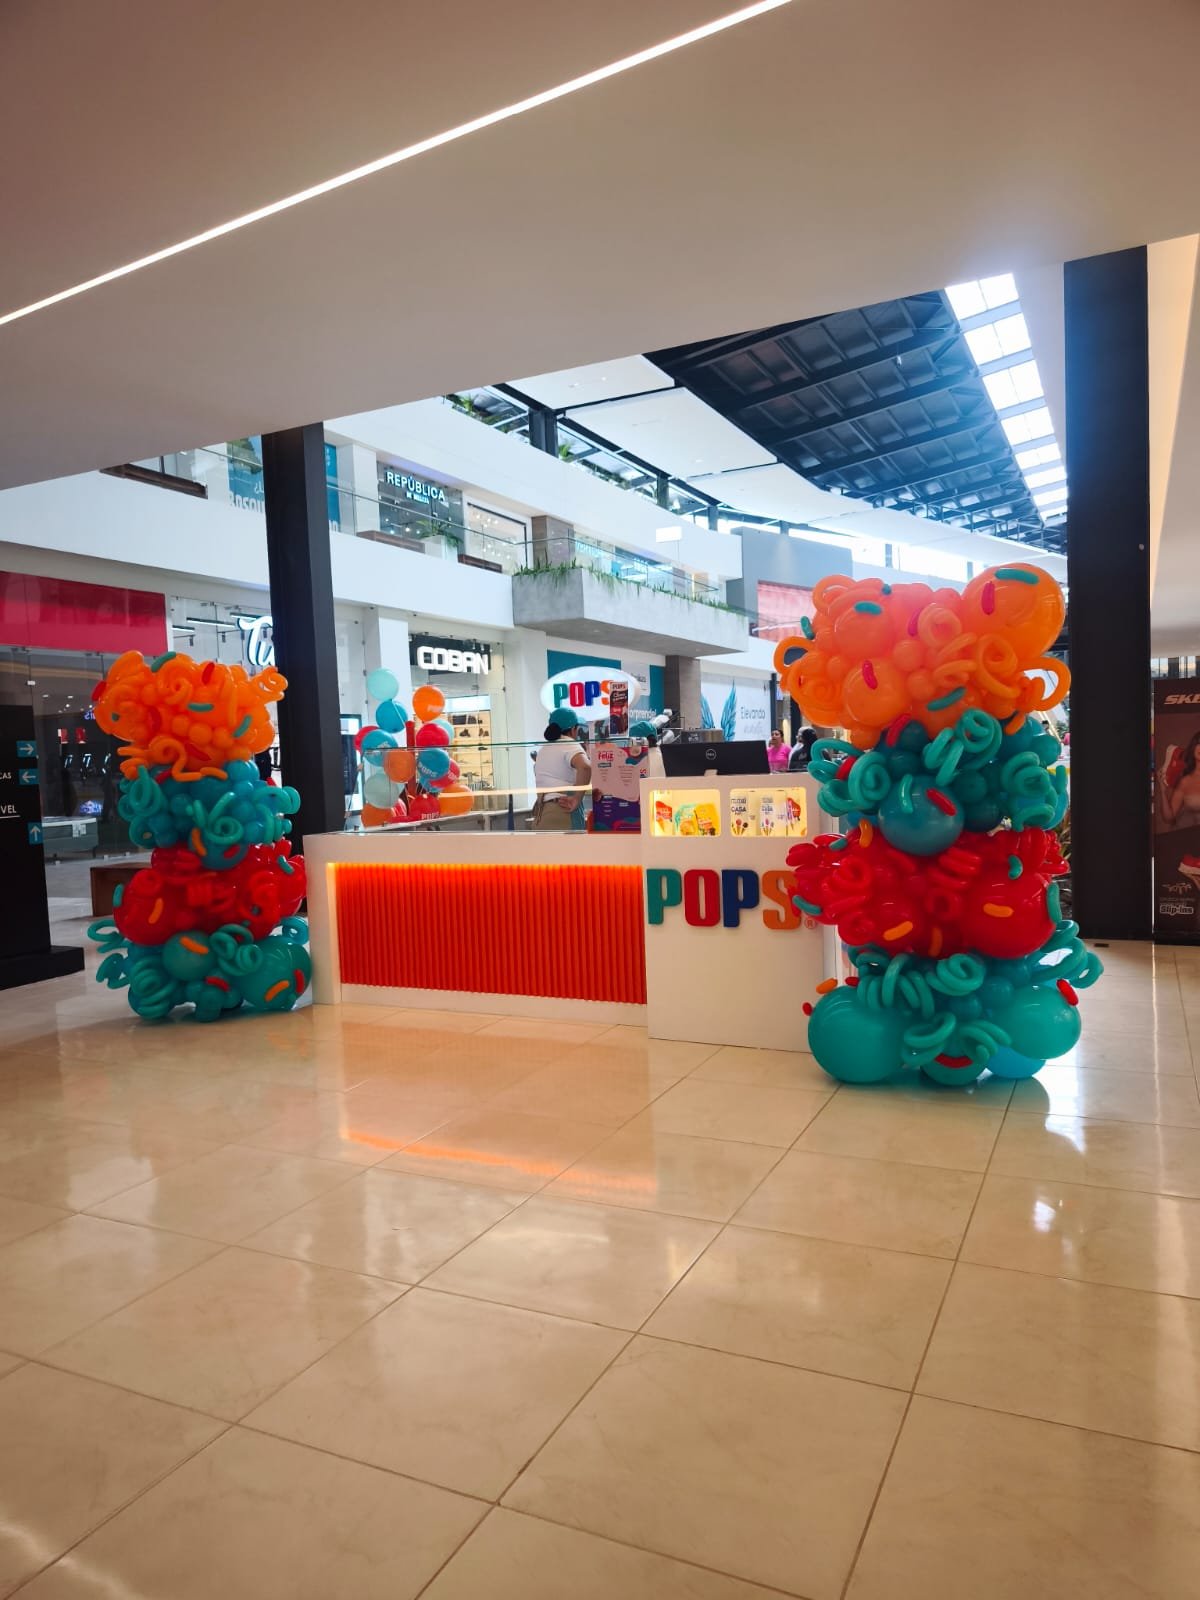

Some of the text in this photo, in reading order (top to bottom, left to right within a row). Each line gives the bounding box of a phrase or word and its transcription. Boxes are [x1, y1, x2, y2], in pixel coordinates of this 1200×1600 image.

[386, 471, 446, 502] REPÚBLICA
[416, 645, 489, 675] COBAN
[553, 679, 613, 709] POPS
[646, 868, 803, 931] POPS
